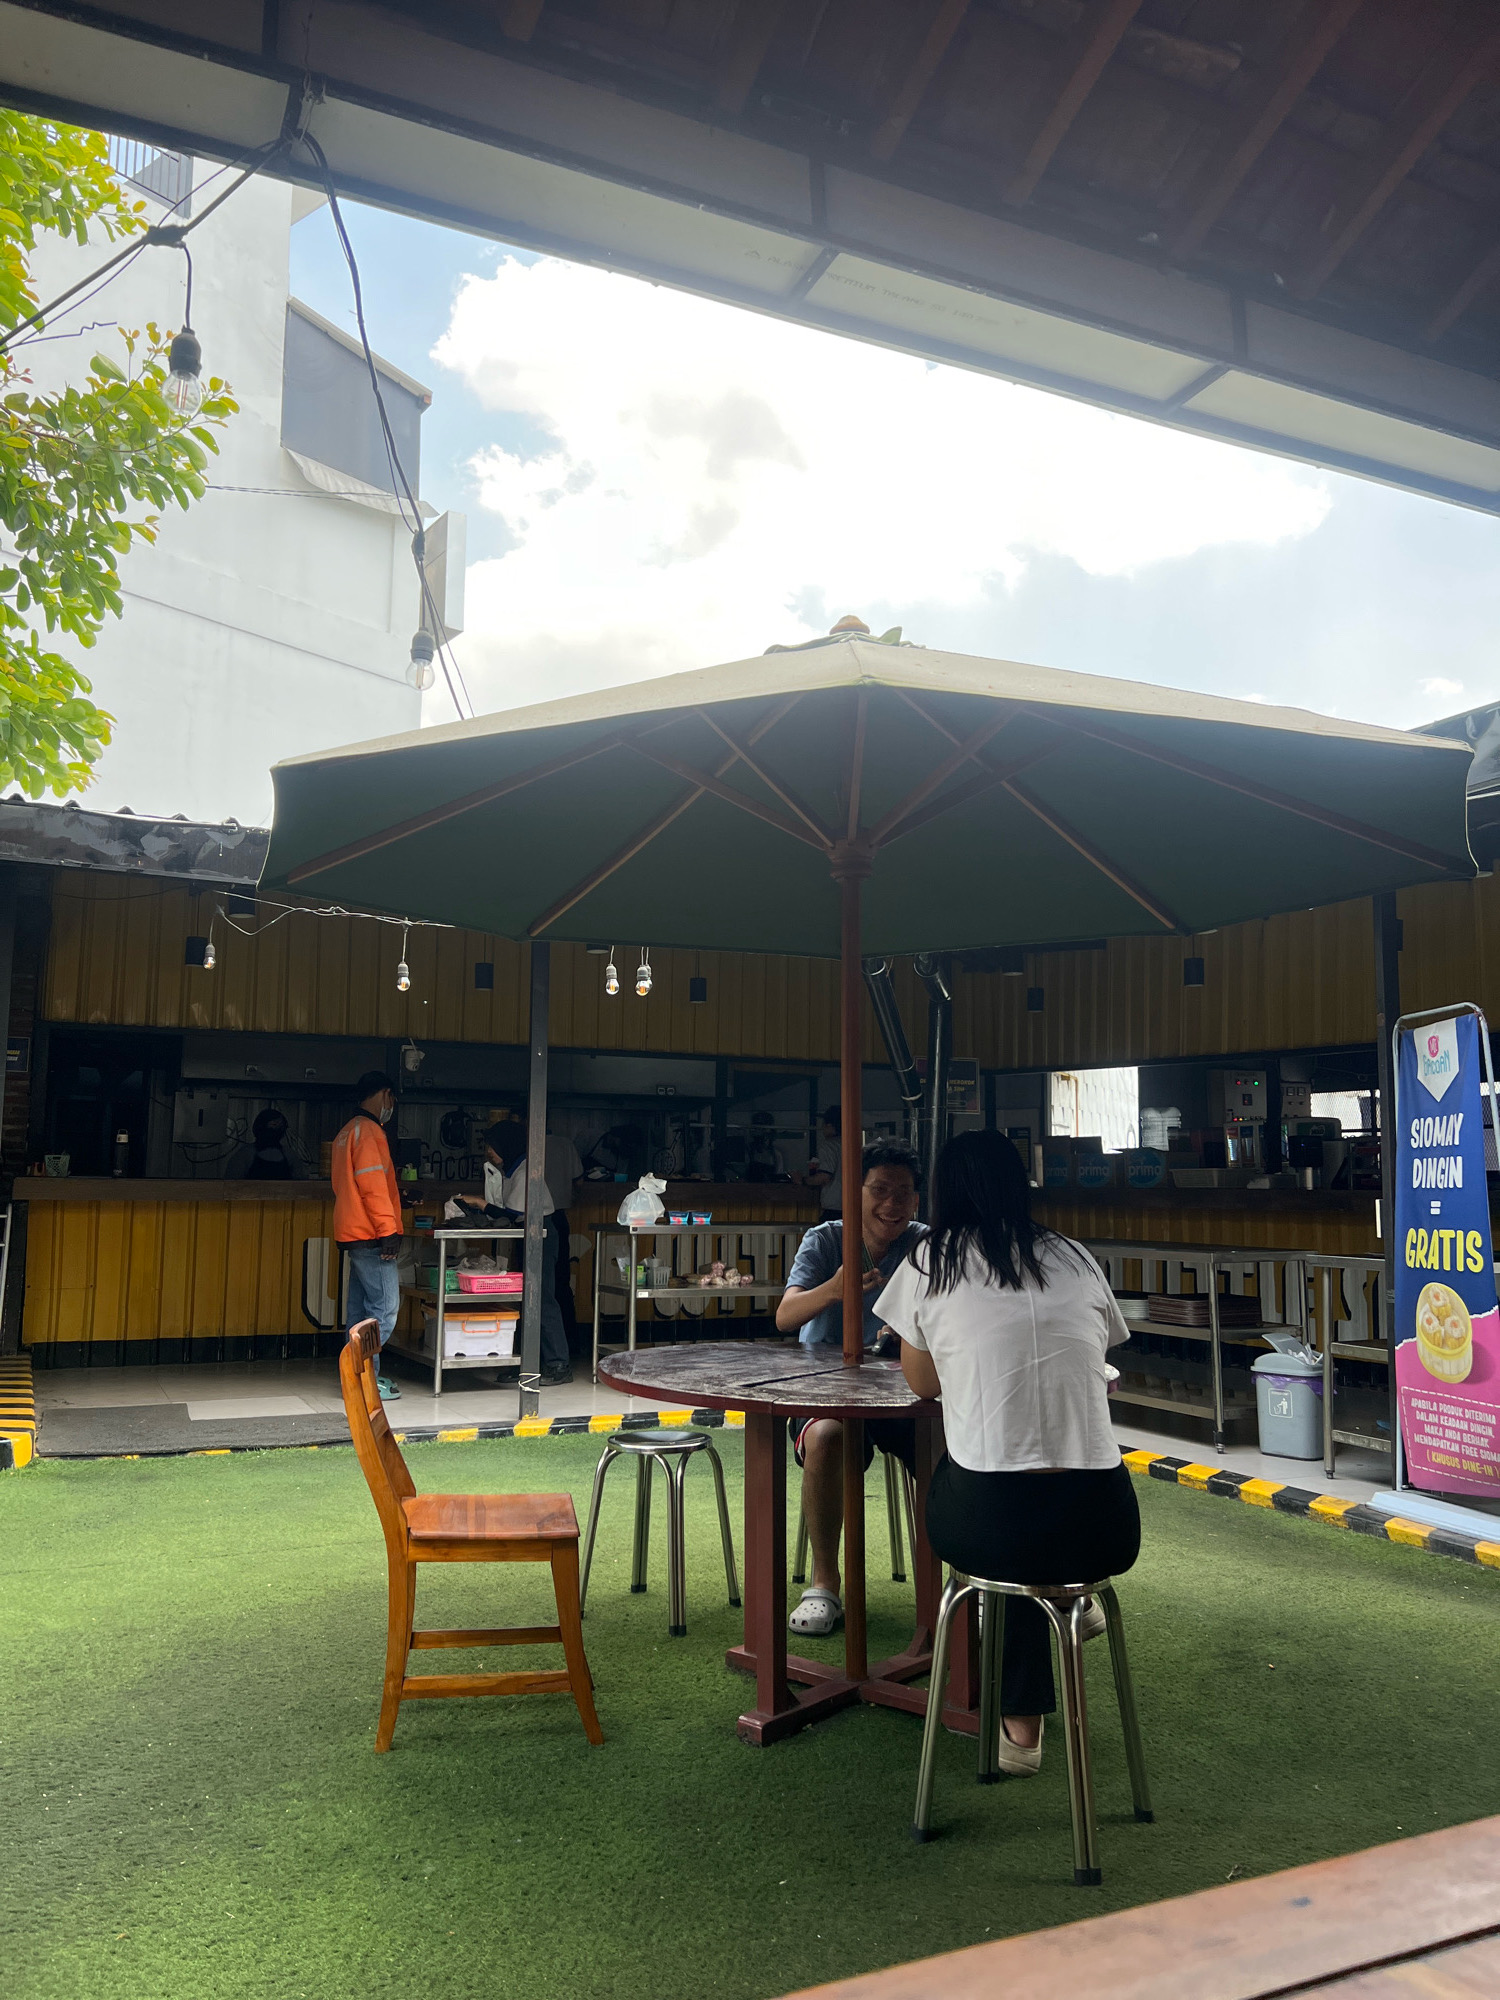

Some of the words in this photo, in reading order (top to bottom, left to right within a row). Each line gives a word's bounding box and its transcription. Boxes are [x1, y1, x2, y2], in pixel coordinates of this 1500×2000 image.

[1410, 1112, 1464, 1149] SIOMAY
[1412, 1156, 1463, 1189] DINGIN
[1405, 1227, 1484, 1273] GRATIS
[1411, 1397, 1437, 1412] APABILA
[1439, 1403, 1463, 1418] PRODUK
[1465, 1408, 1496, 1425] DITERIMA
[1416, 1410, 1438, 1424] DALAM
[1414, 1433, 1460, 1454] MENDAPATKAN
[1461, 1445, 1478, 1458] FREE
[1424, 1424, 1443, 1437] MAKA
[1445, 1428, 1461, 1441] ANDA
